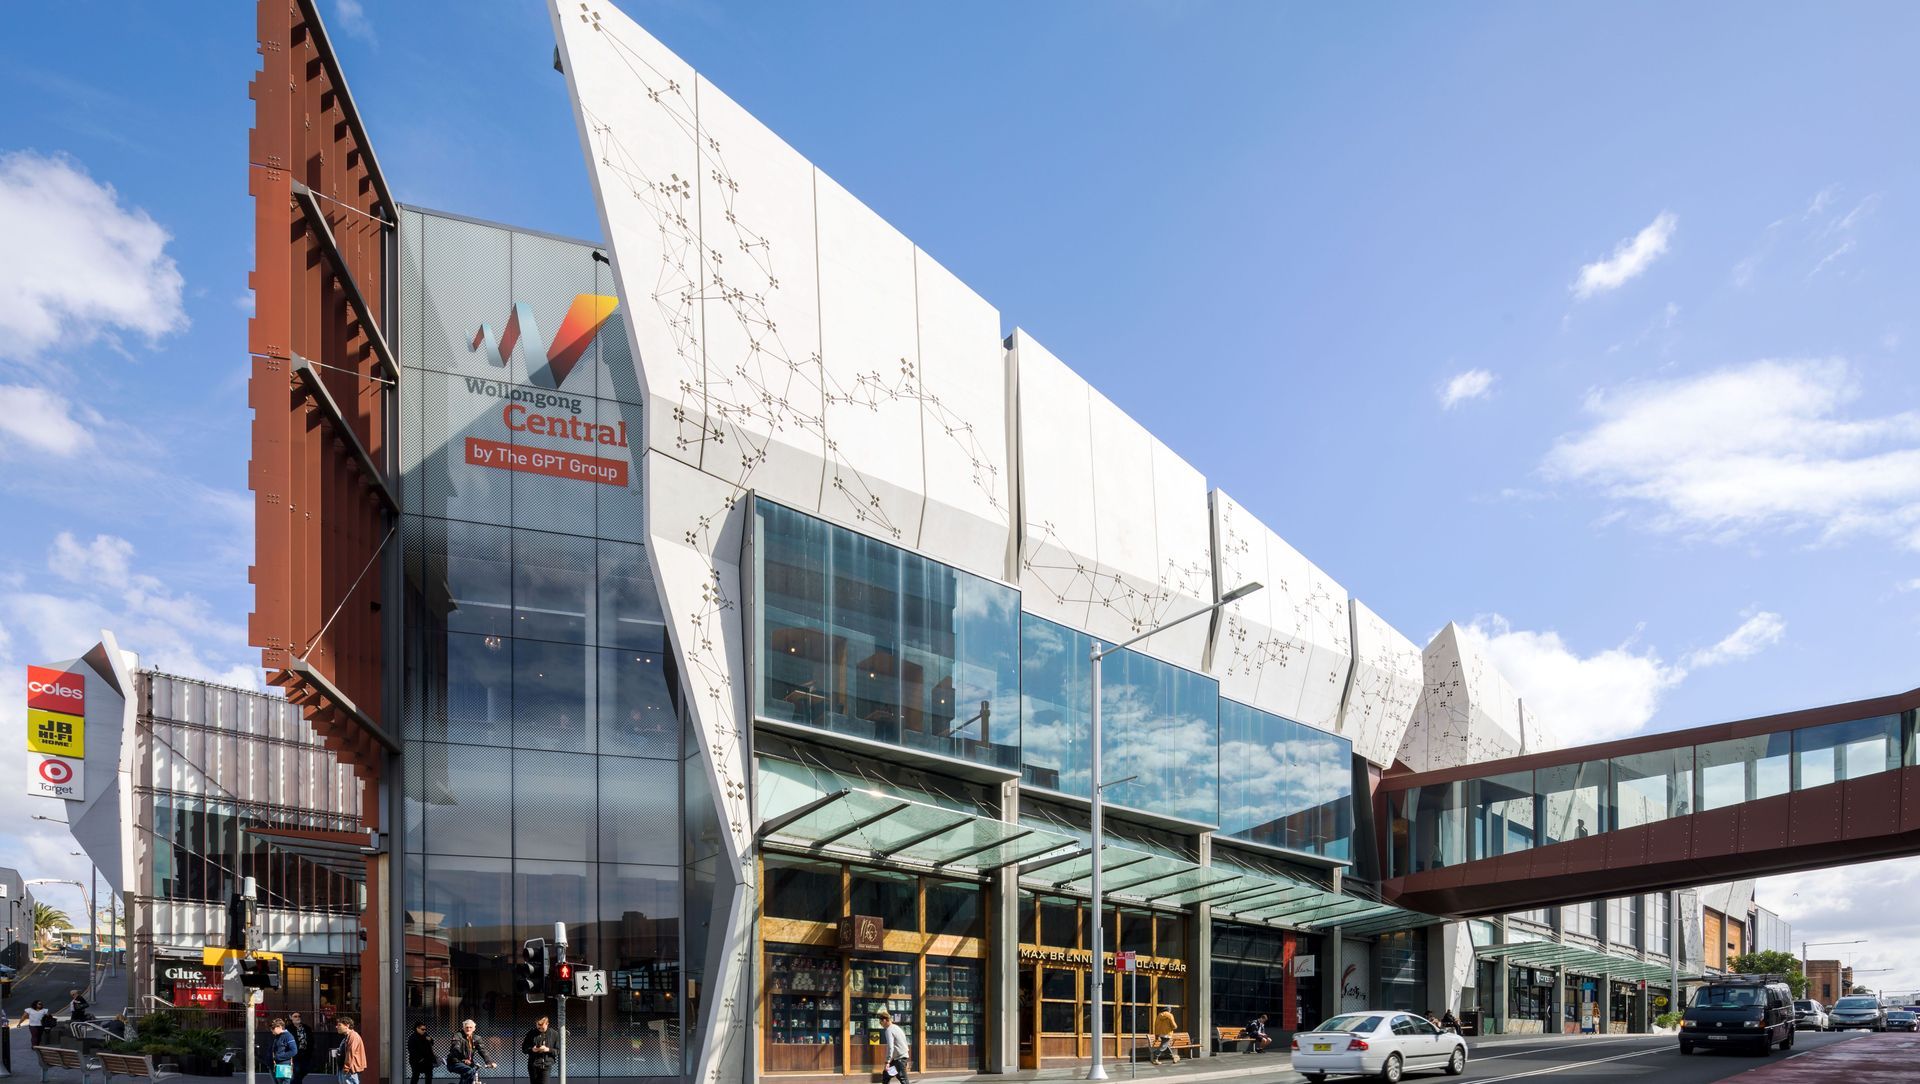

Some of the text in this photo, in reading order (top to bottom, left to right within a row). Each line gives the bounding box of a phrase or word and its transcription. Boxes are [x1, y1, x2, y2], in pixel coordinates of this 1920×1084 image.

[464, 377, 582, 414] Wollongong
[503, 403, 628, 448] Central
[474, 445, 618, 480] by The GPT Group
[28, 681, 83, 700] coles
[38, 720, 72, 734] JB
[41, 739, 69, 747] HOME
[39, 782, 73, 795] Target
[1021, 949, 1046, 960] MAX
[1168, 962, 1187, 972] BAR
